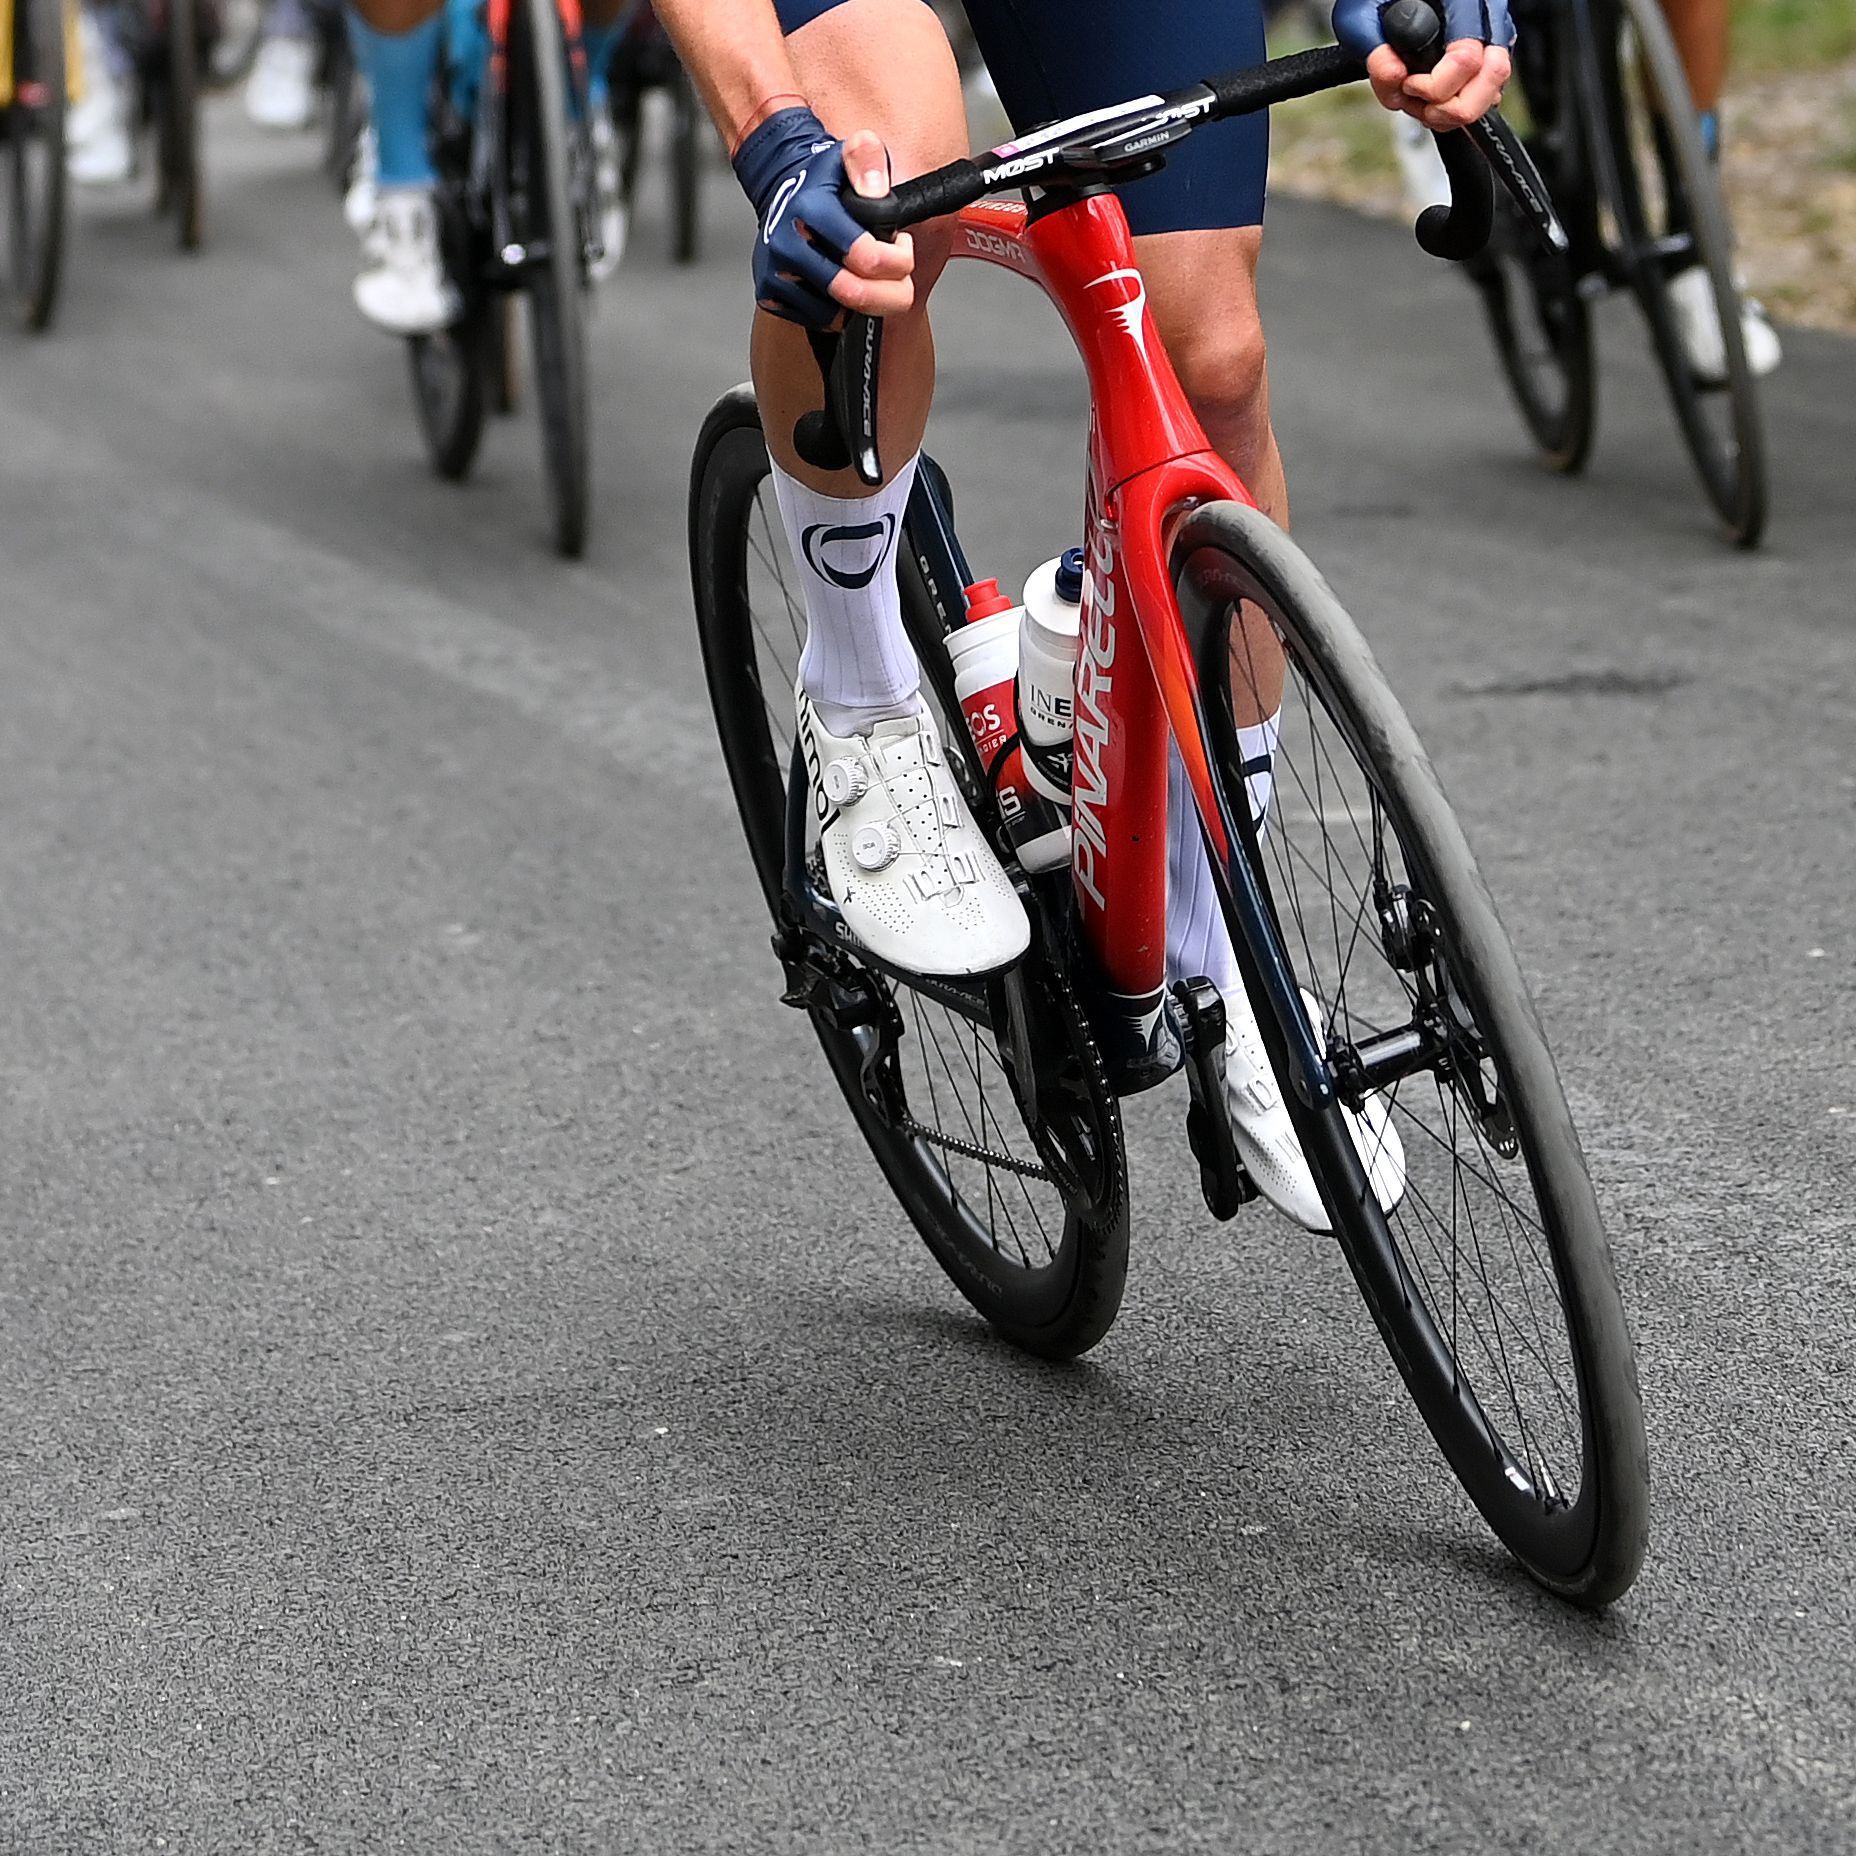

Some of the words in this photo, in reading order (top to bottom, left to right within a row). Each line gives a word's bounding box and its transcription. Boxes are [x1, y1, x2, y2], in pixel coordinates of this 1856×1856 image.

[1124, 130, 1170, 153] GARMIN
[863, 317, 875, 438] DURA-ACE
[1030, 684, 1072, 718] INE
